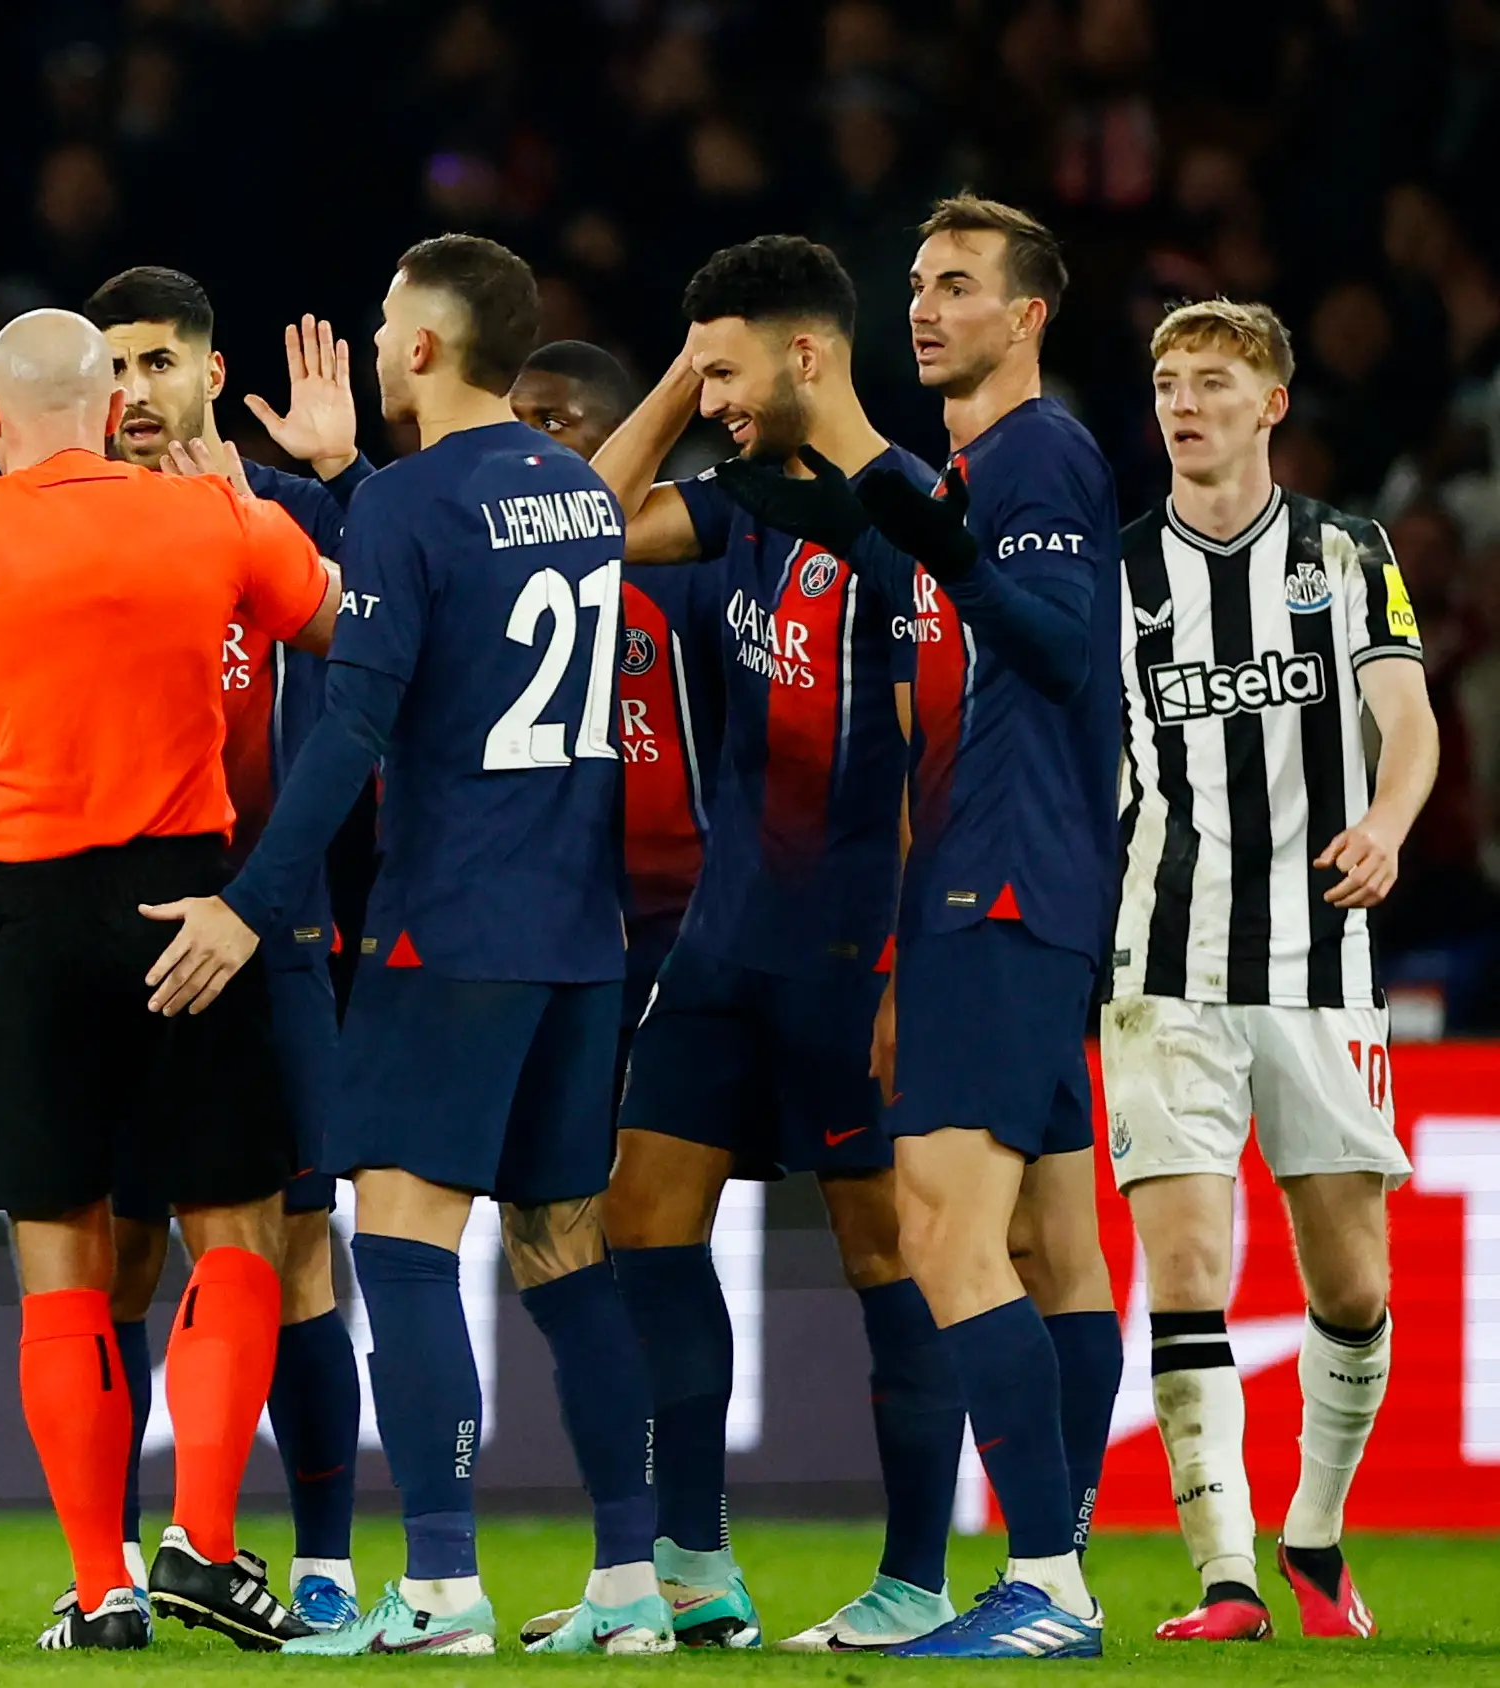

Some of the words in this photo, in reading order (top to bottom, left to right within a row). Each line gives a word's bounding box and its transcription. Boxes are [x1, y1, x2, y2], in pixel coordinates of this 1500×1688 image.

[998, 532, 1084, 560] GOAT
[726, 588, 812, 664] QATAR
[482, 559, 622, 771] 21
[736, 640, 815, 688] AIRWAYS
[1208, 654, 1320, 711] sela
[454, 1418, 476, 1479] PARIS
[1072, 1486, 1098, 1546] PARIS
